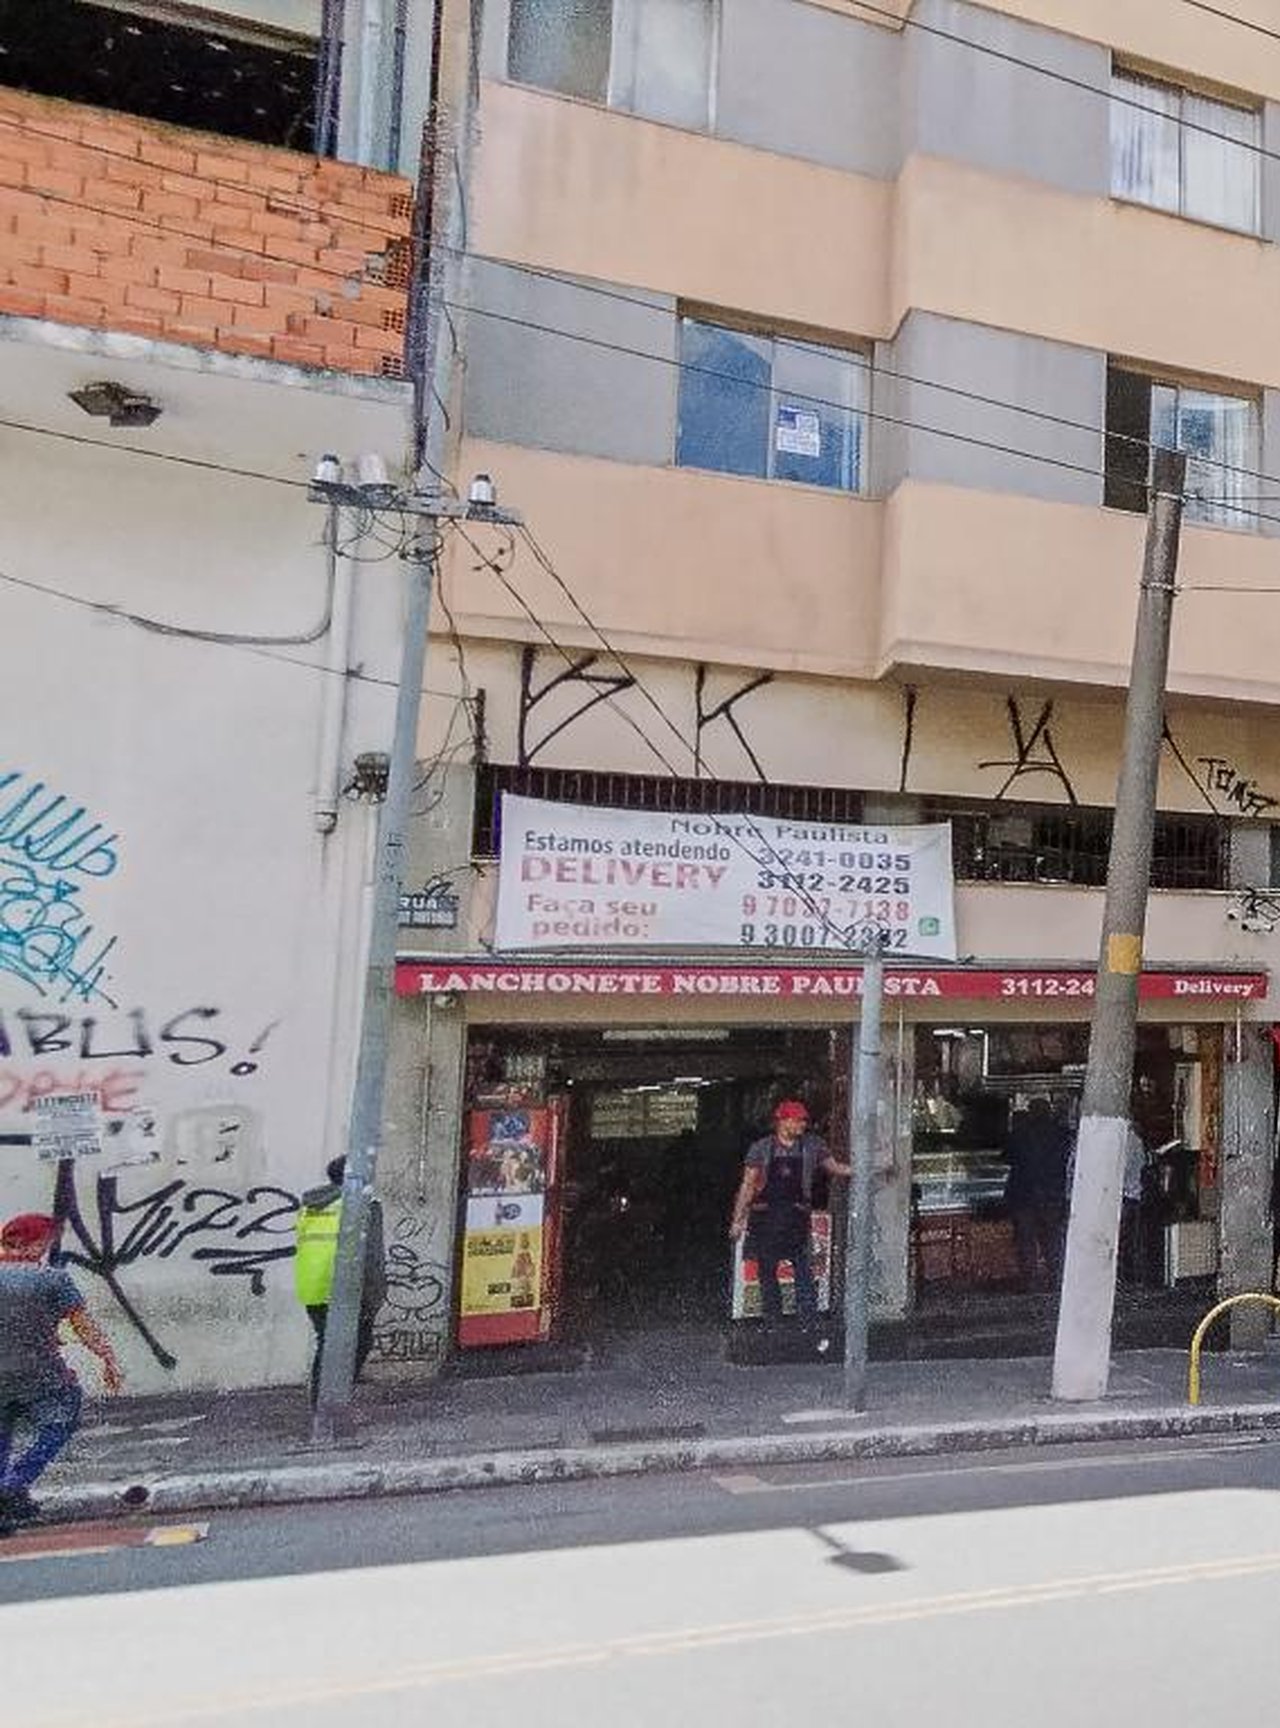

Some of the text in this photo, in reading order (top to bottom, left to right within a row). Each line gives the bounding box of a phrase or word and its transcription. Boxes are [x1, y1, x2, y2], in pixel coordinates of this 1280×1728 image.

[671, 818, 889, 846] Nobre Paulista
[524, 829, 731, 862] Estamos atendendo
[520, 853, 728, 890] DELIVERY
[527, 894, 658, 919] Faça seu
[531, 918, 649, 940] pedido:
[419, 973, 941, 996] LANCHONETE NOBRE PAUSTA
[1001, 977, 1095, 997] 3112-24
[1173, 980, 1255, 999] Delivery
